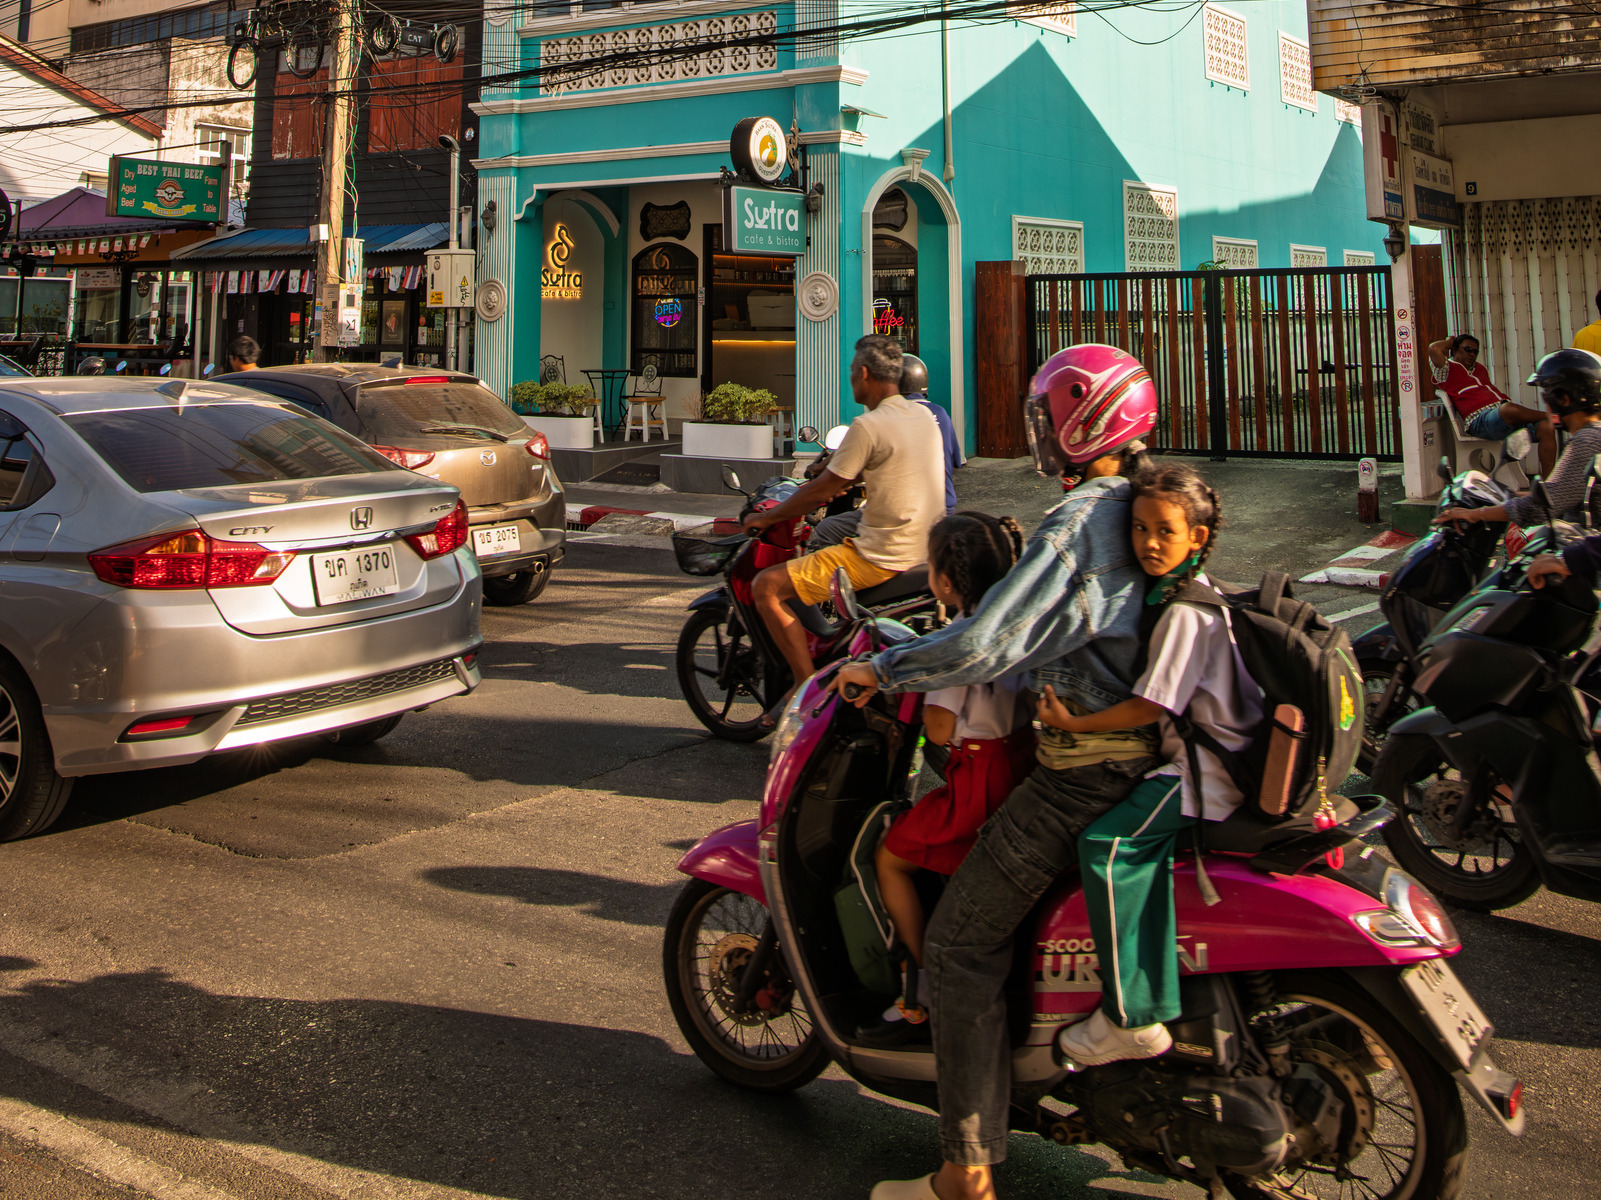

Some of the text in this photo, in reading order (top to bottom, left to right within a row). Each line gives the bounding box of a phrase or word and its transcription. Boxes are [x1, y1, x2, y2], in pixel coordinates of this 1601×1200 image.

[408, 34, 422, 43] CAT
[124, 169, 135, 181] Dry
[137, 164, 204, 180] BEST THAI BEEF
[204, 176, 217, 186] Farm
[121, 183, 136, 194] Aged
[207, 190, 213, 198] to
[1467, 184, 1475, 194] 9
[121, 197, 135, 207] Beef
[203, 203, 216, 213] Table
[744, 198, 799, 231] Sutra
[744, 234, 799, 246] cafe & bistro
[541, 268, 582, 287] Sutra
[655, 303, 681, 315] OPEN
[1398, 350, 1412, 358] จอด
[228, 525, 276, 537] CITY
[496, 528, 516, 541] 2075
[356, 554, 390, 574] 1370
